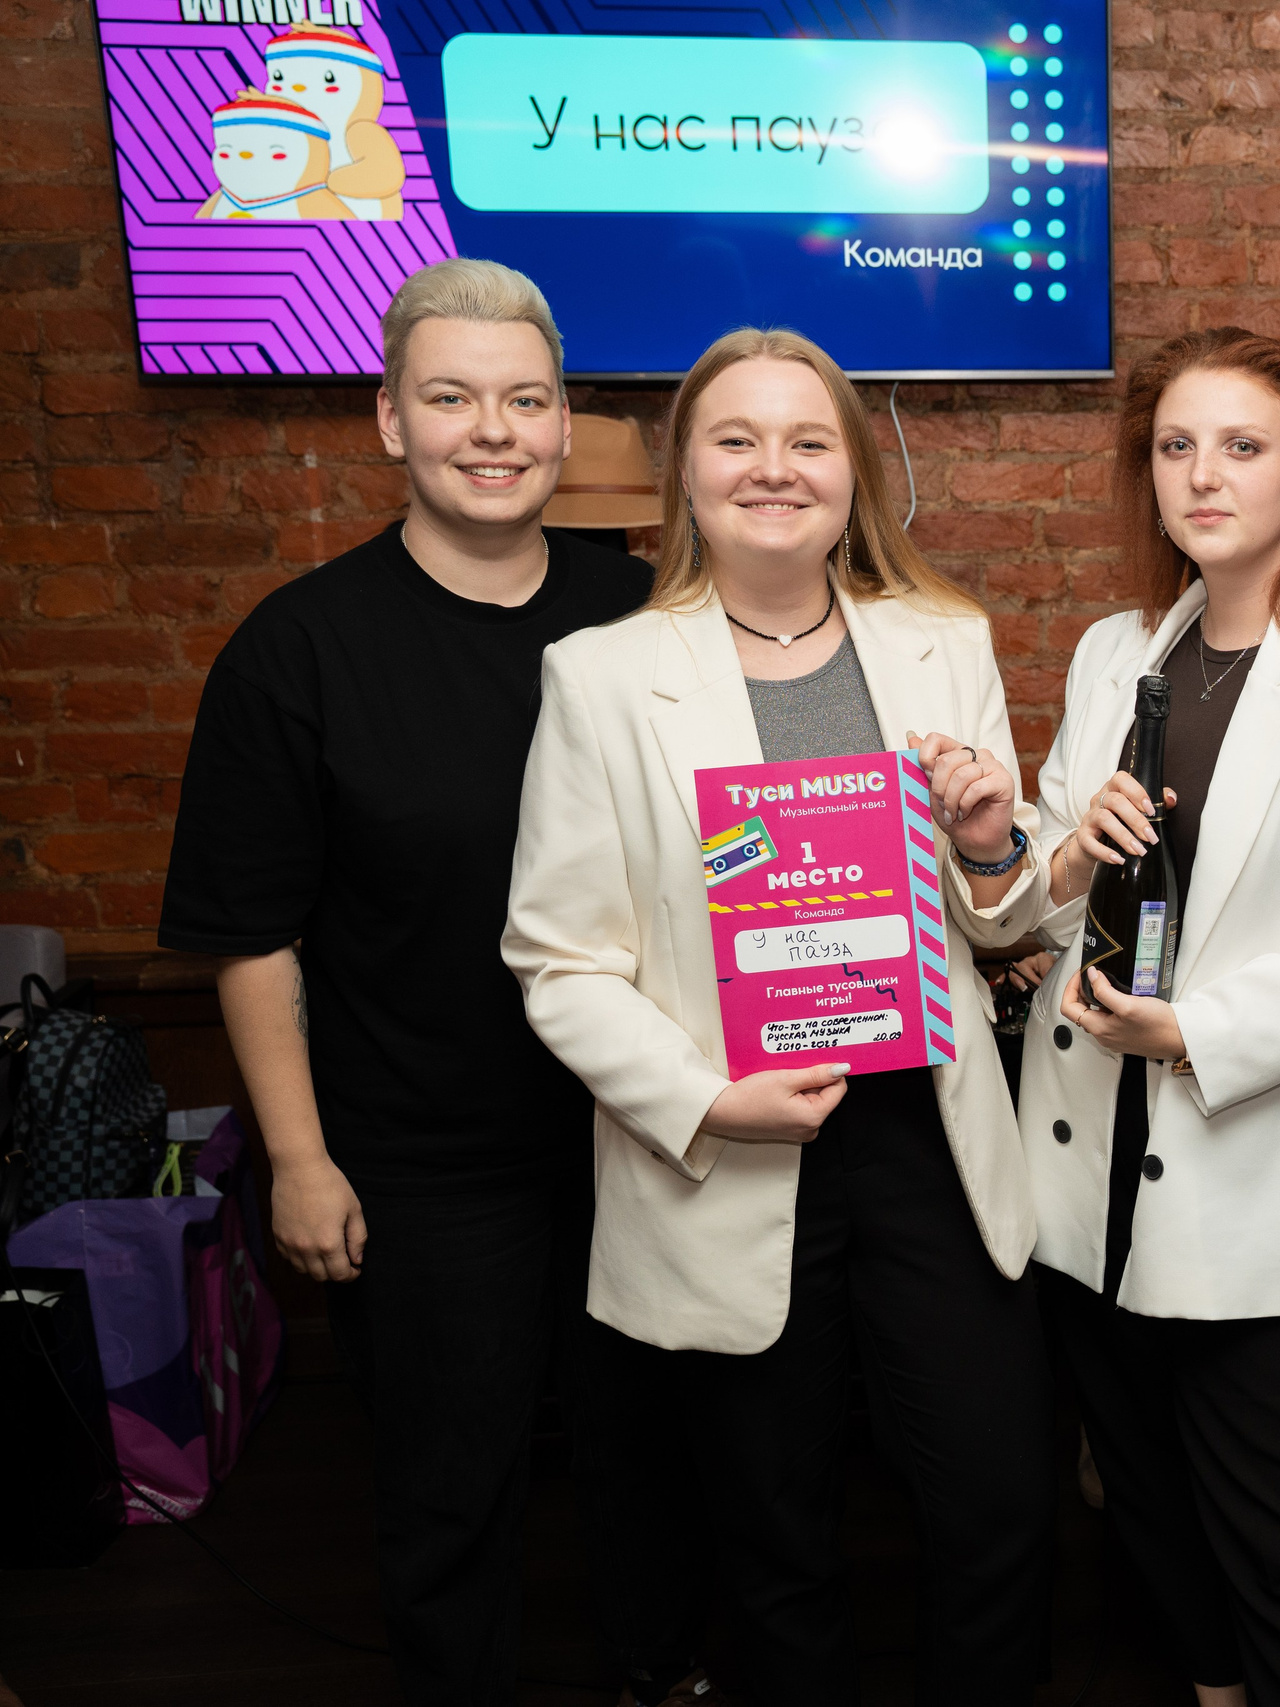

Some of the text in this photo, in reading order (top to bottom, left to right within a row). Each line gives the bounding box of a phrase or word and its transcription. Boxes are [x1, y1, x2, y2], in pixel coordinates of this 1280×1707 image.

[529, 95, 909, 165] У нас пауз
[843, 239, 982, 272] Команда
[725, 771, 886, 809] Туси MUSIC
[779, 800, 887, 818] Музыкальный квиз
[800, 841, 816, 864] 1
[767, 864, 864, 890] место
[794, 906, 845, 919] Команда
[766, 976, 899, 999] Главные тусовщики
[815, 992, 853, 1008] игры!
